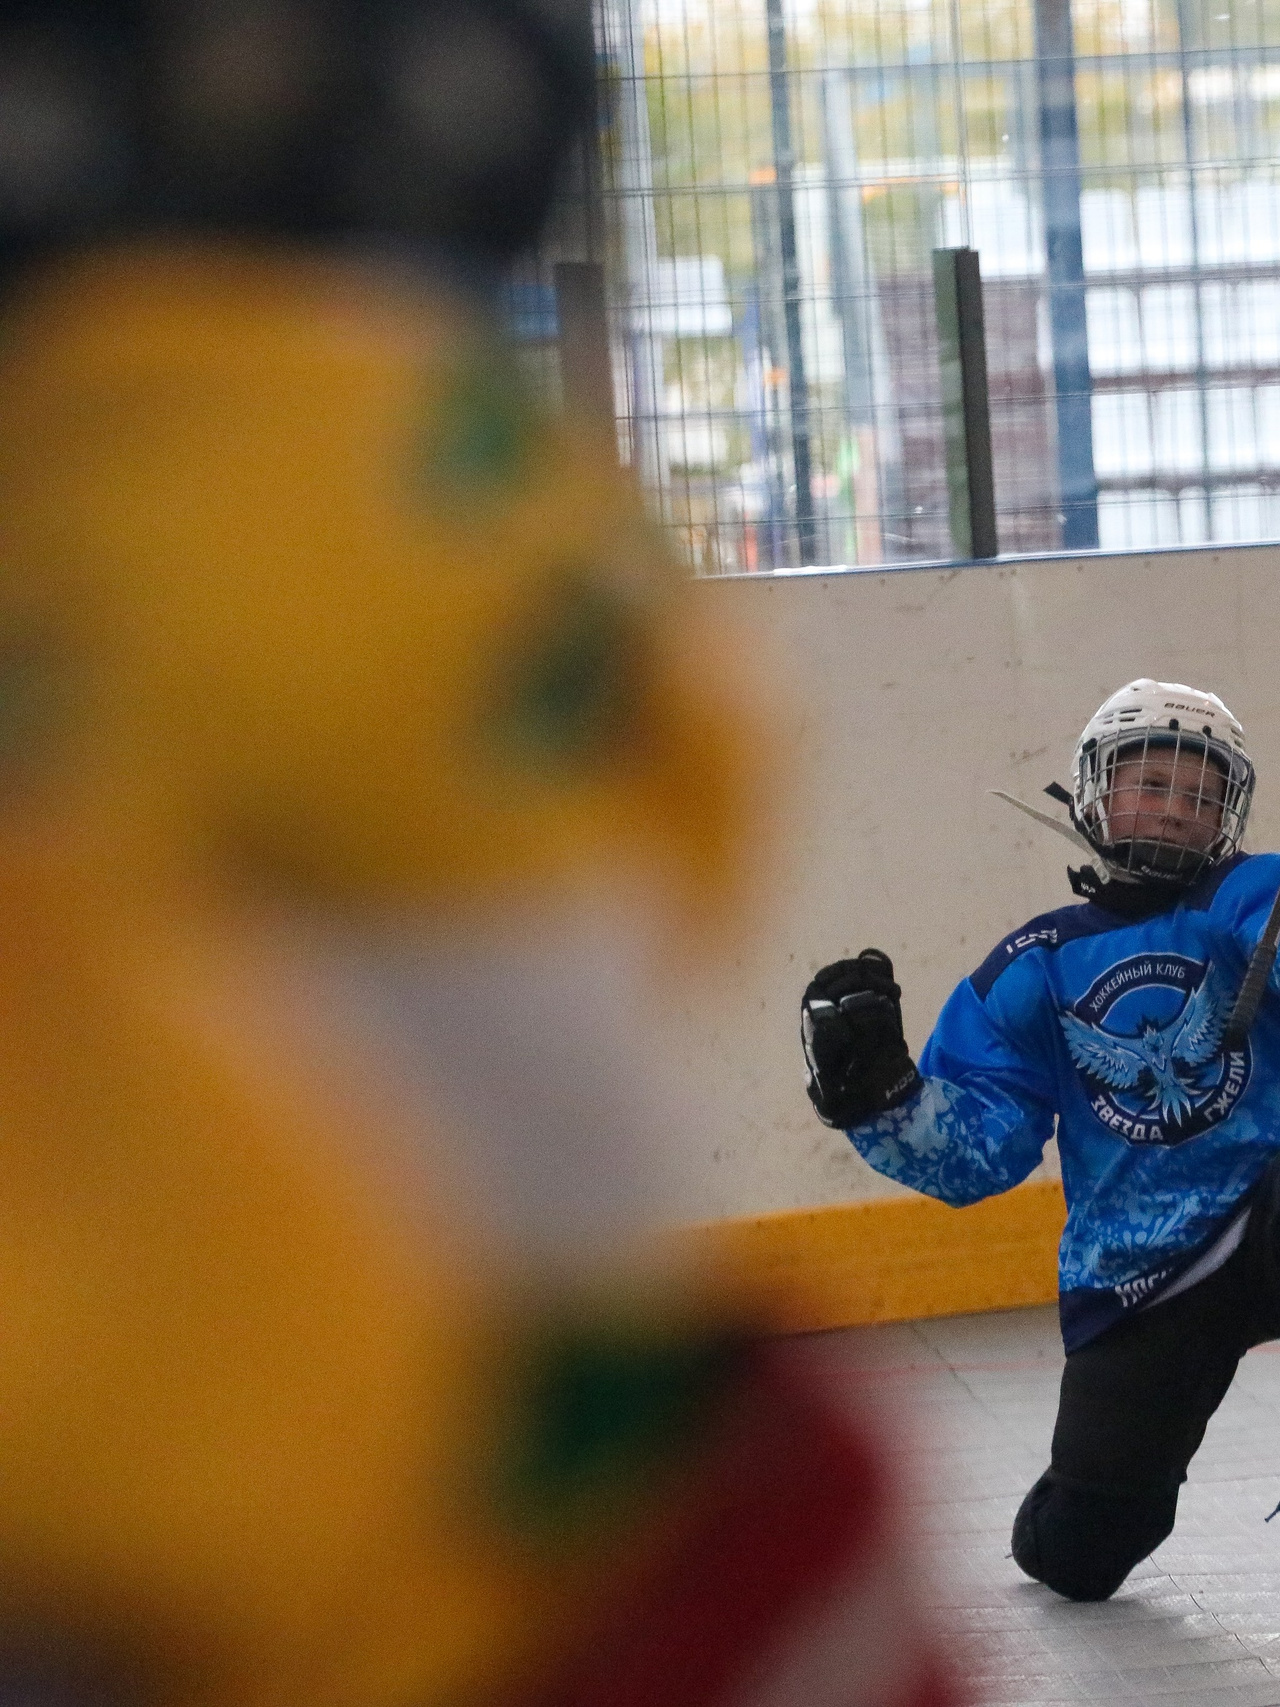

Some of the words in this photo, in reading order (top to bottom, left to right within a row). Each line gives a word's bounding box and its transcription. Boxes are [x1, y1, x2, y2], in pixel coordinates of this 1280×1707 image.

[1164, 702, 1216, 718] BAUER
[1089, 959, 1153, 1013] ХОККЕЙНЫЙ
[1155, 962, 1187, 980] КЛУБ
[1091, 1094, 1164, 1142] ЗВЕЗДА
[1203, 1050, 1246, 1123] ГЖЕЛИ
